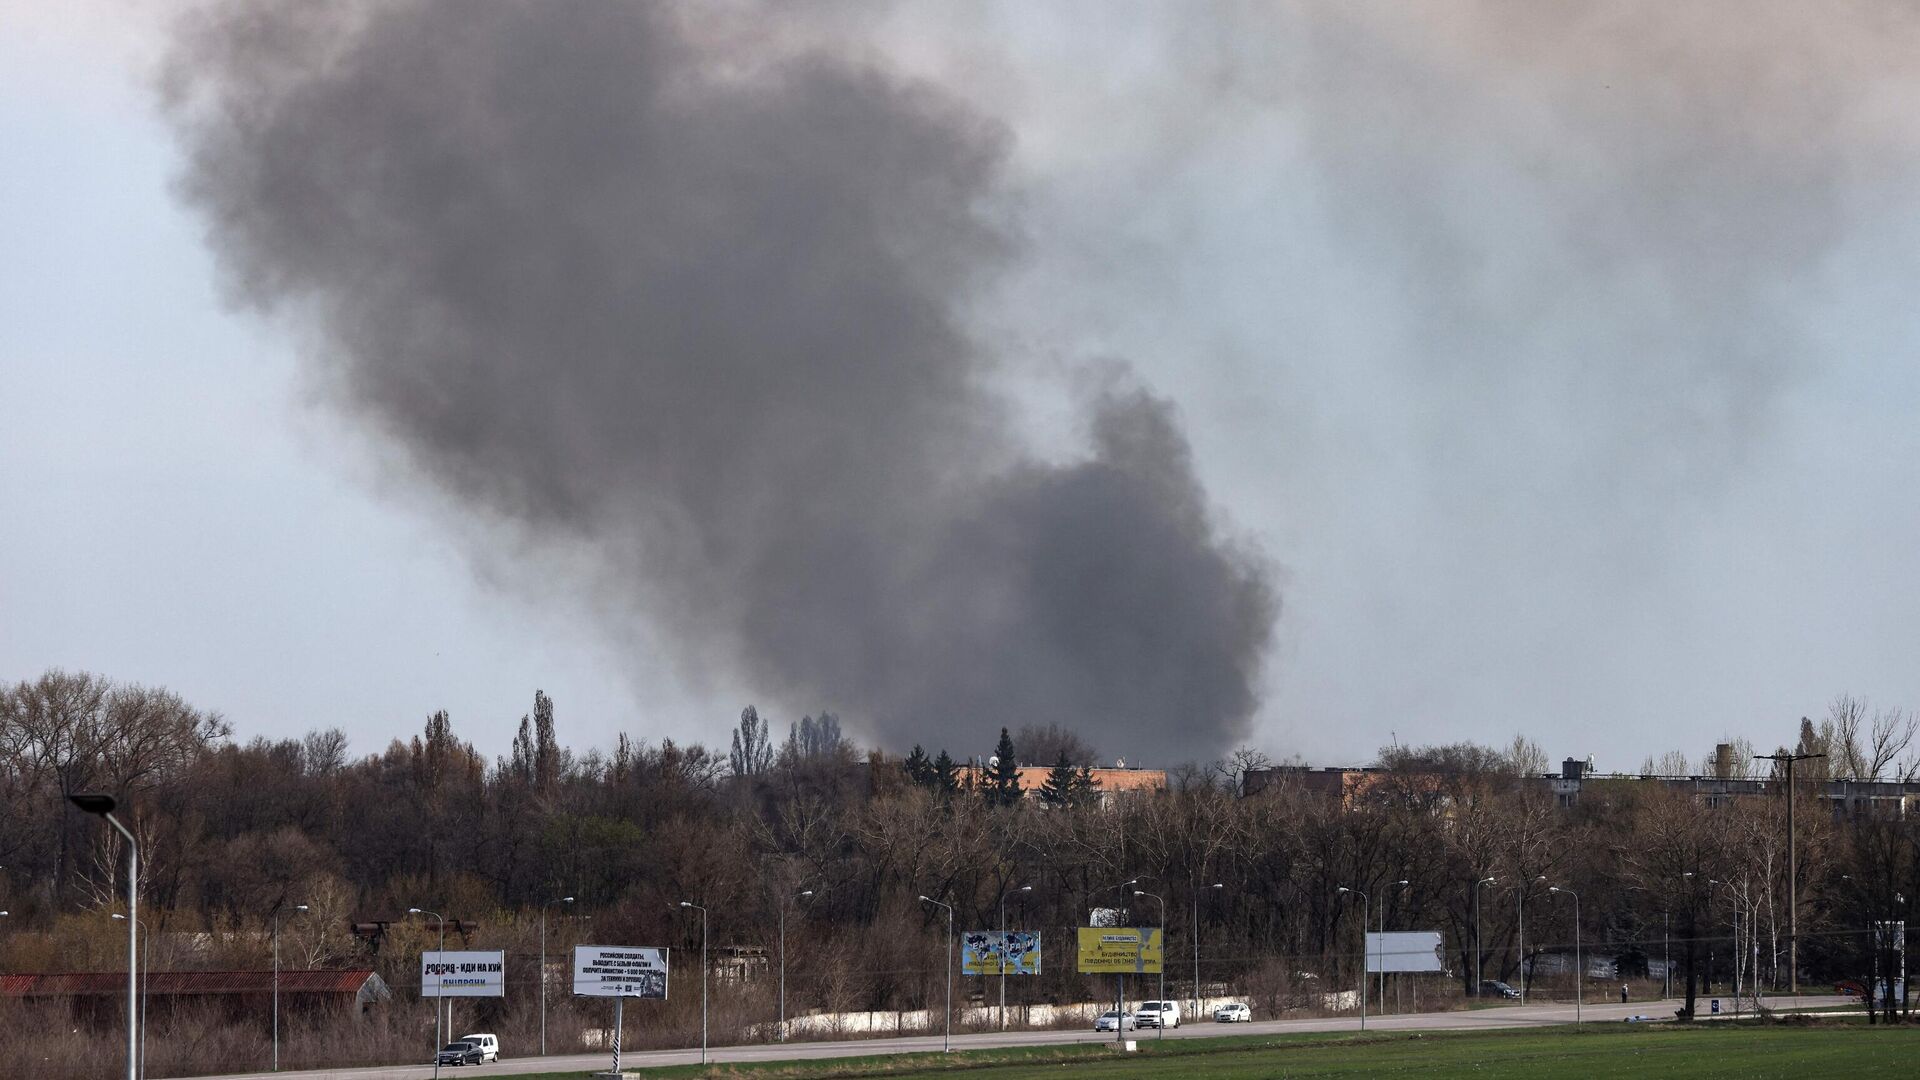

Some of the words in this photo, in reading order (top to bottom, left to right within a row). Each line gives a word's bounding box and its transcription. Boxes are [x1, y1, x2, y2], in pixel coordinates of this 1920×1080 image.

[425, 963, 455, 975] РОССИЯ
[460, 963, 476, 973] ИДИ
[477, 963, 487, 972] НА
[488, 962, 502, 972] ХУЙ
[441, 979, 486, 988] ДНІПРЯНИ
